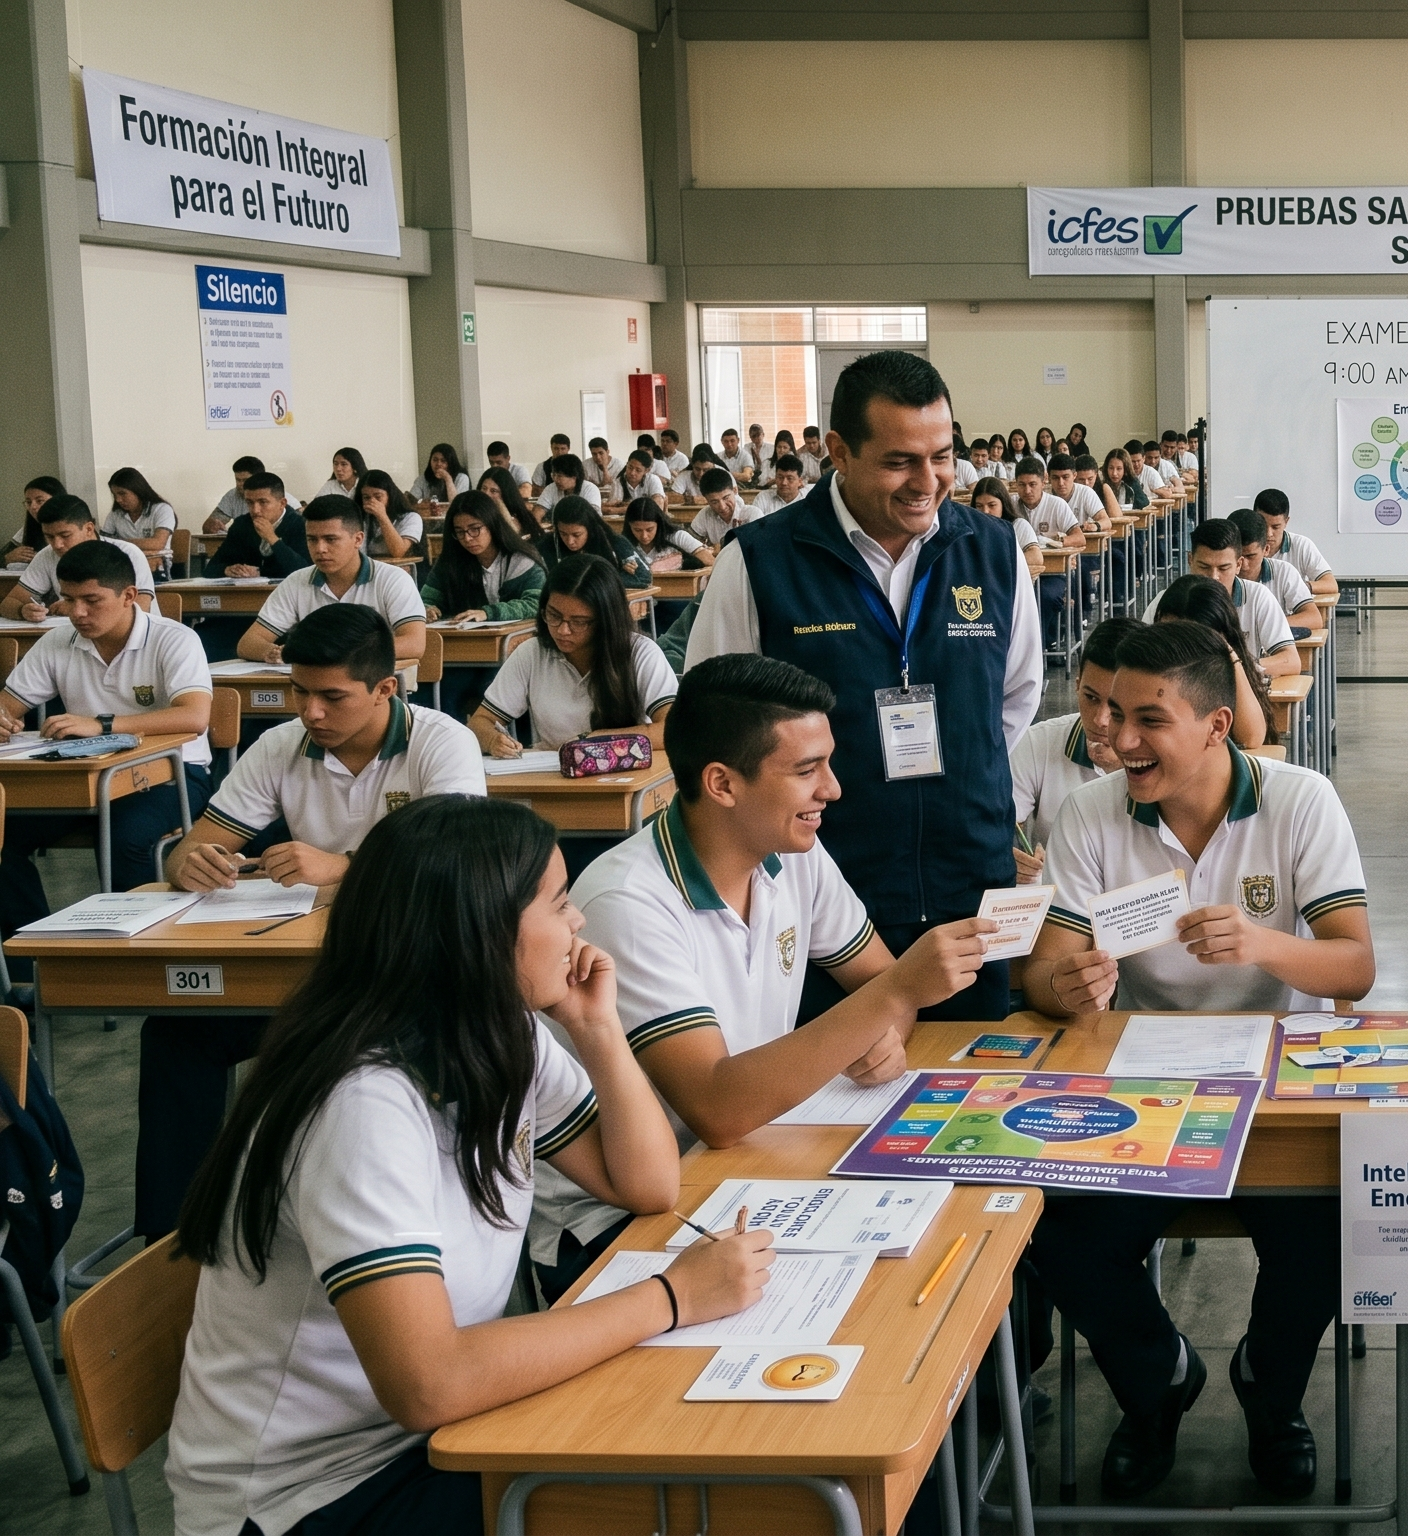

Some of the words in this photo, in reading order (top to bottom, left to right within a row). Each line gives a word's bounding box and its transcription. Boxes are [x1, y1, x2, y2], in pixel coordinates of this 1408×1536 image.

[119, 95, 271, 168] Formación
[277, 129, 368, 190] Integral
[169, 174, 234, 218] para
[242, 180, 266, 221] el
[272, 183, 350, 233] Futuro
[1216, 197, 1358, 226] PRUEBAS
[1047, 207, 1139, 244] icfes
[207, 274, 278, 306] Silencio
[1323, 361, 1375, 385] 9:00
[176, 971, 211, 989] 301
